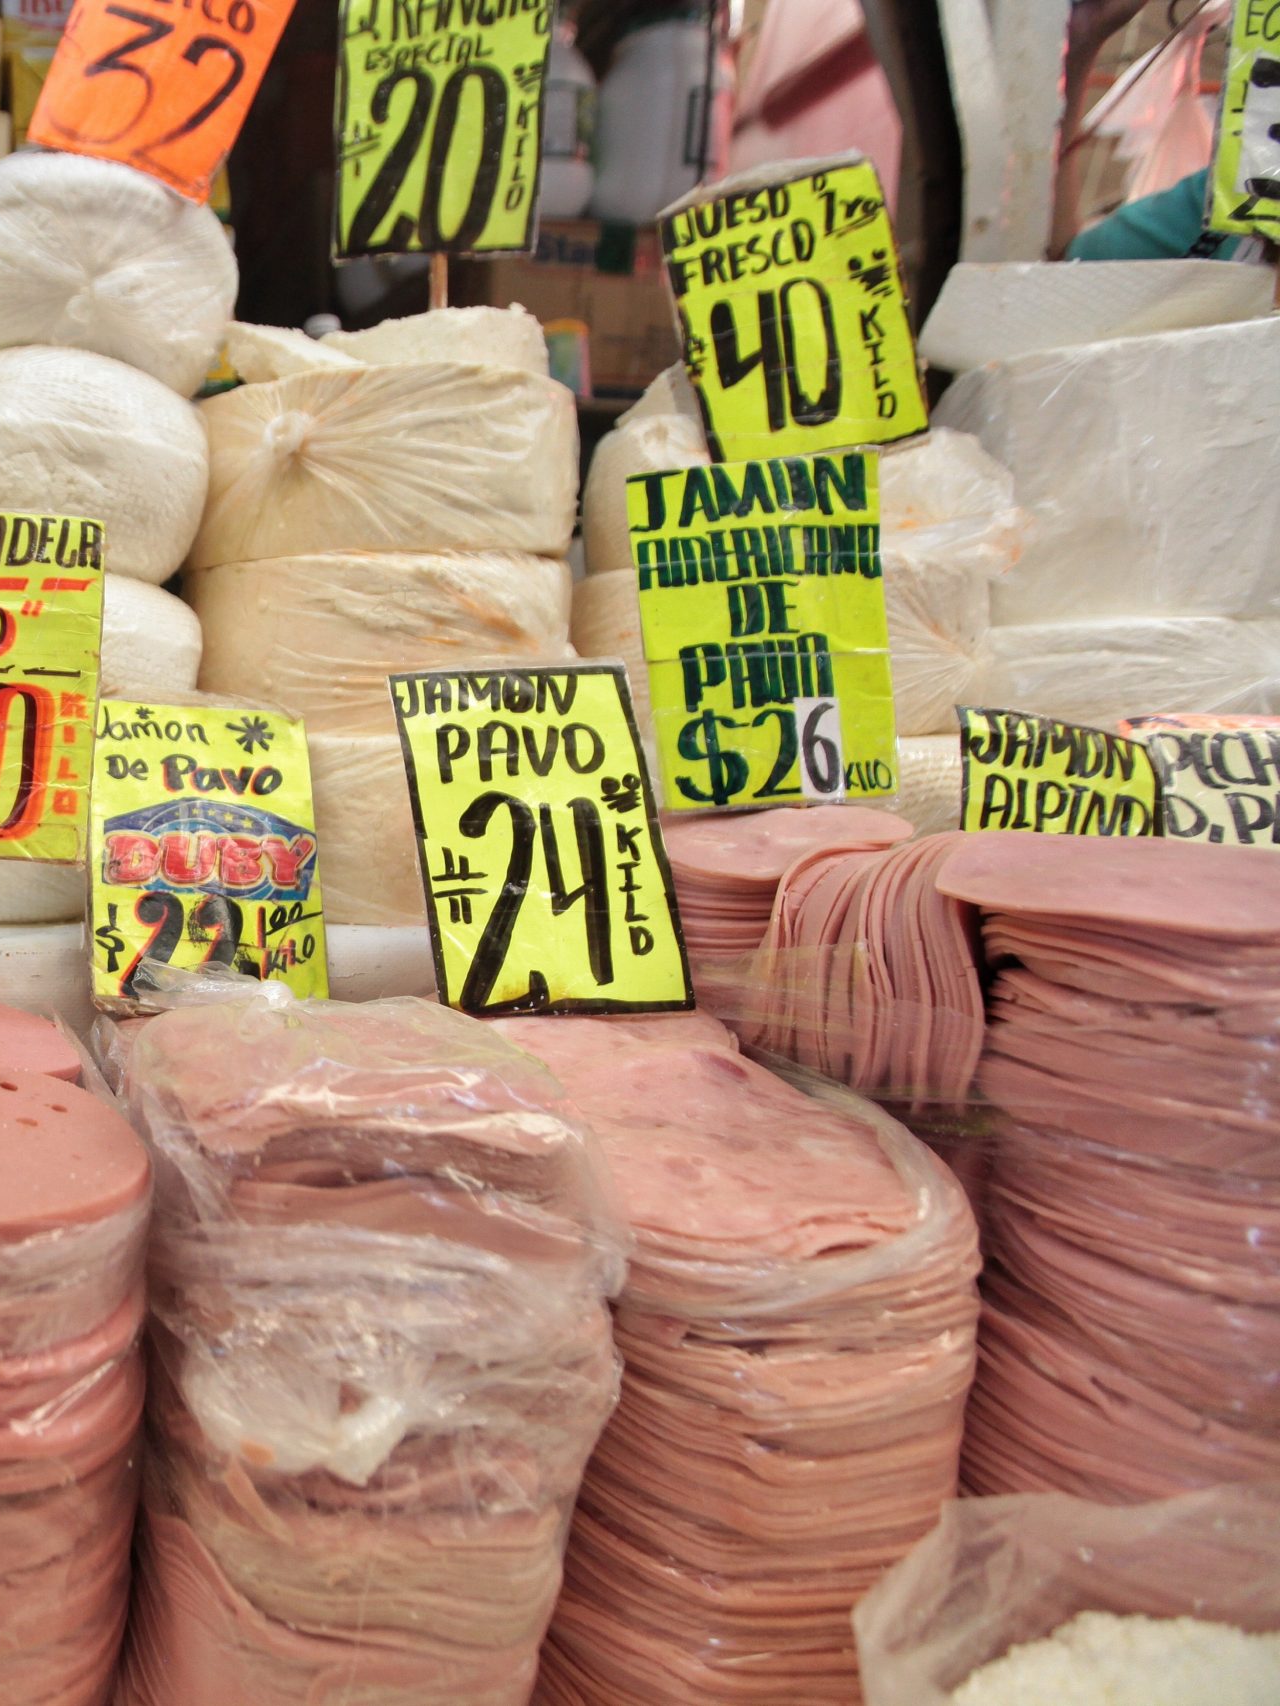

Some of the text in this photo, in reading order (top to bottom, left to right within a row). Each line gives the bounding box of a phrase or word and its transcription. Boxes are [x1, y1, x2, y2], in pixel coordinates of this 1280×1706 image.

[666, 184, 791, 250] QUESO
[669, 218, 816, 297] FRESCO
[858, 303, 898, 418] KILO
[626, 453, 869, 532] JAMON
[636, 522, 883, 591] AMERICANO
[726, 580, 803, 638] DE
[399, 674, 578, 720] JAMON
[52, 692, 91, 817] KILO
[104, 753, 284, 797] De Pavo
[436, 719, 606, 784] PAVO
[676, 702, 840, 806] $26
[970, 710, 1137, 783] JAMON
[979, 773, 1154, 837] ALPINO
[104, 829, 317, 886] DUBY
[613, 823, 655, 957] KILO
